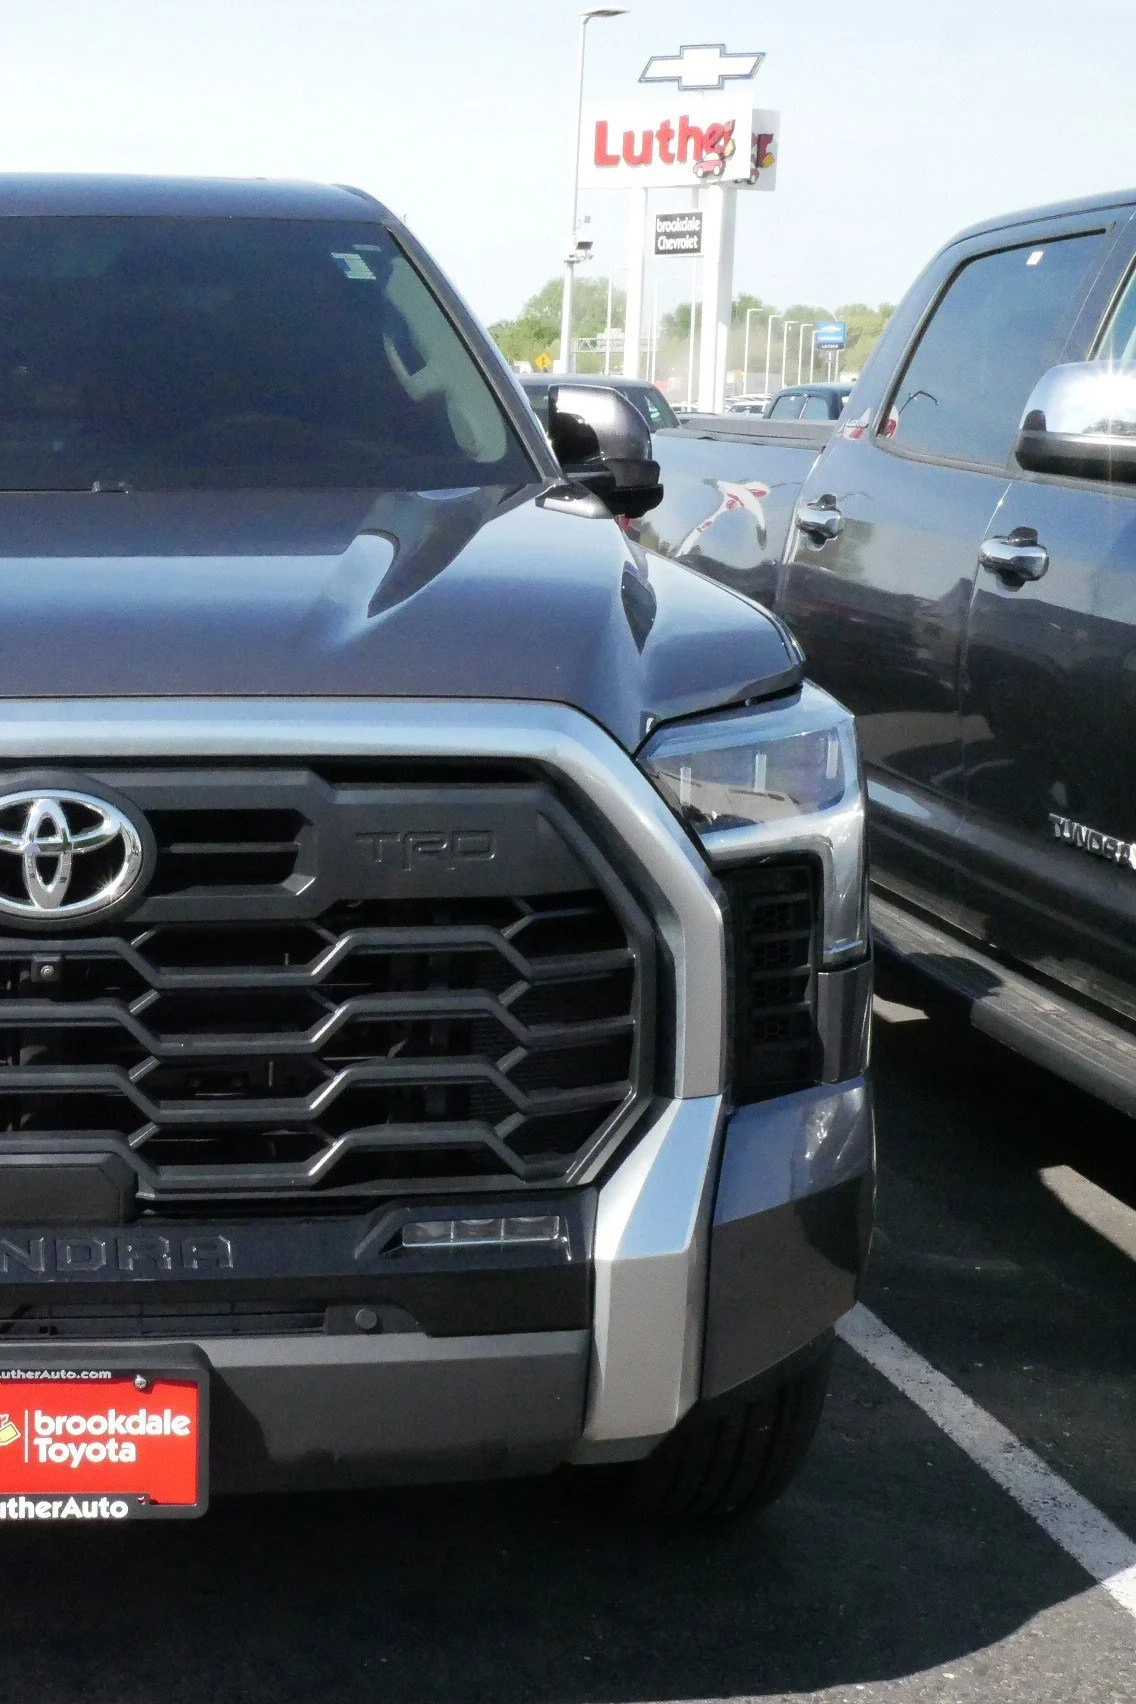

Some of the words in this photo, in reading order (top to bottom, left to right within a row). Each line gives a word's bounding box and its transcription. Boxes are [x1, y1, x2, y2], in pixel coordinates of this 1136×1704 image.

[594, 115, 736, 167] Luther
[657, 217, 701, 232] brookdale
[657, 234, 699, 250] Chevrolet
[354, 829, 497, 871] TRD
[1048, 812, 1130, 864] TUNDRA
[33, 1409, 191, 1436] brookdale
[33, 1437, 137, 1468] Toyota
